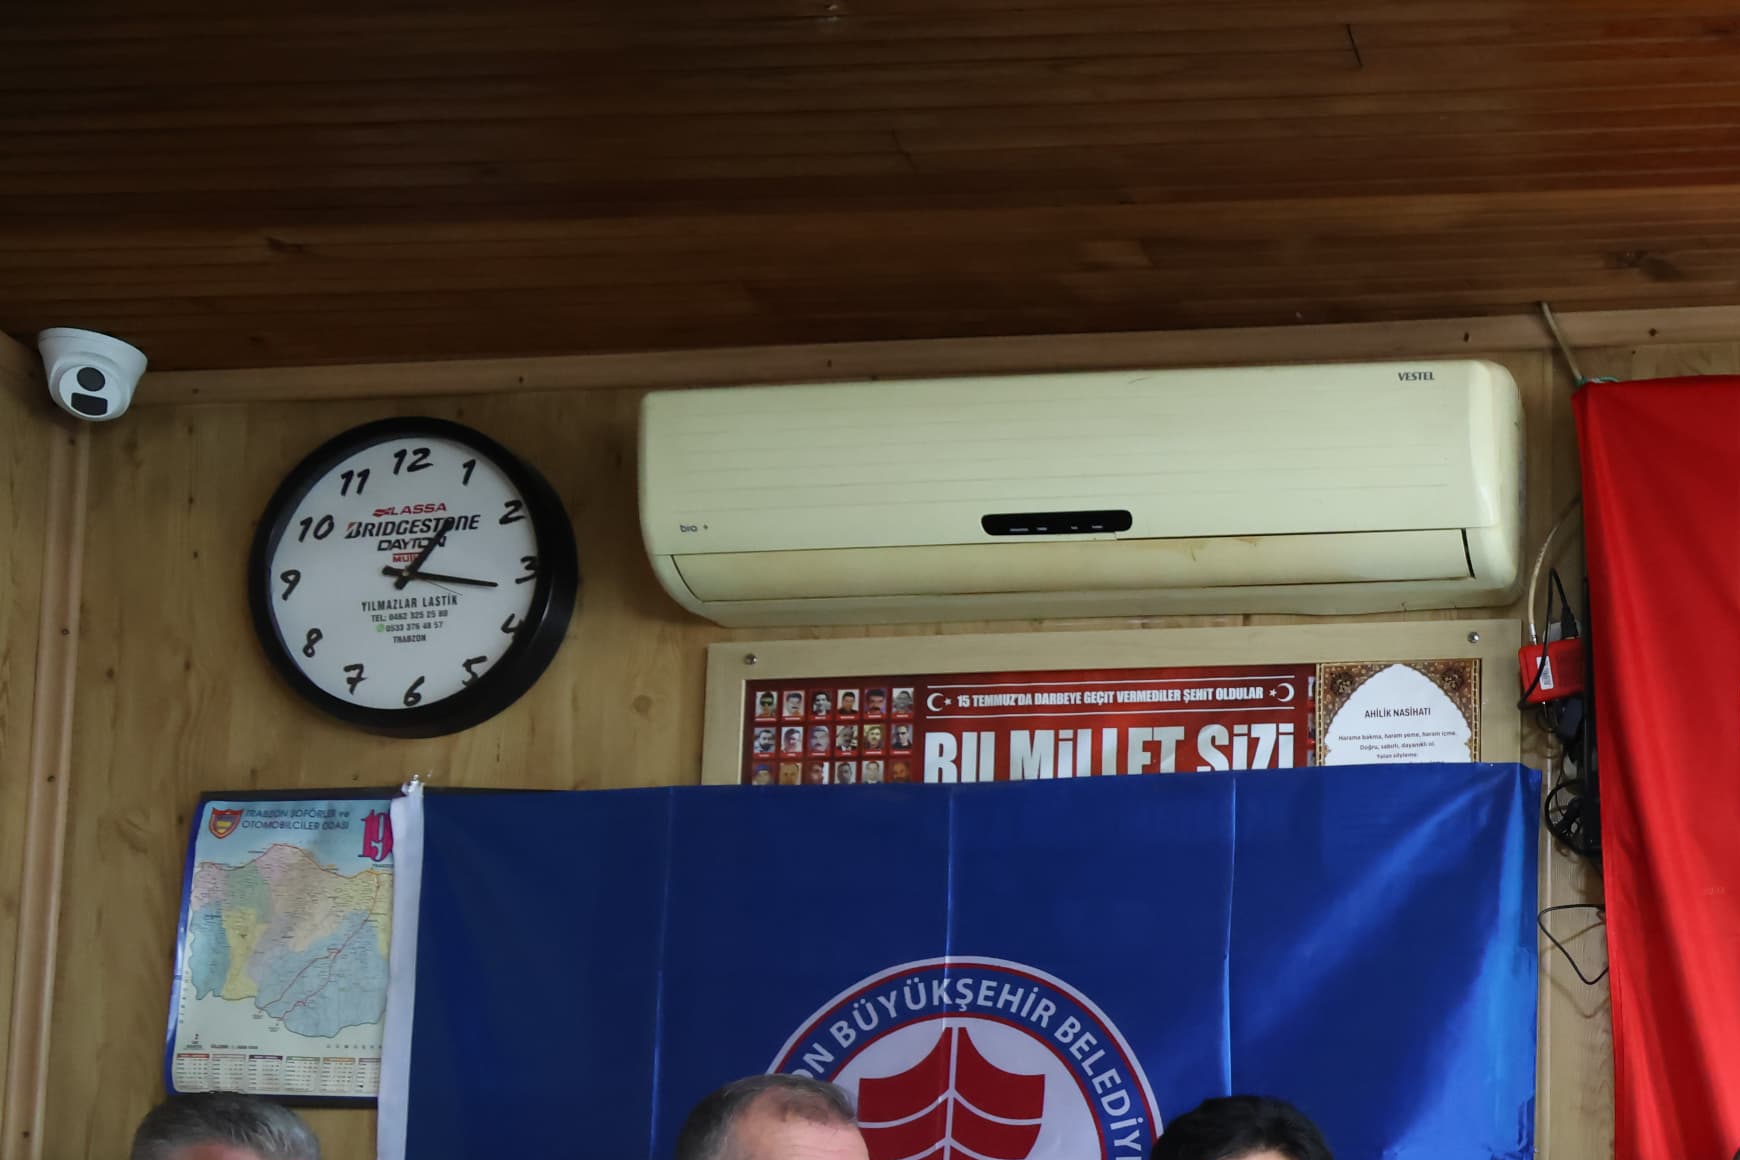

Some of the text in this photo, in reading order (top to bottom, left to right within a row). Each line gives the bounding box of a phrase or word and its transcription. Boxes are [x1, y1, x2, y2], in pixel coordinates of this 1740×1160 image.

[1398, 371, 1435, 381] VESTEL
[393, 448, 434, 475] 12
[462, 459, 476, 486] 1
[340, 468, 370, 496] 11
[390, 502, 447, 516] LASSA
[499, 500, 525, 525] 2
[298, 514, 335, 542] 10
[344, 514, 481, 539] BRIDGESTONE
[515, 556, 538, 584] 3
[280, 569, 301, 601] 9
[361, 597, 418, 612] YILMAZLAR
[501, 614, 525, 641] 4
[302, 628, 323, 658] 8
[344, 664, 368, 695] 7
[462, 656, 487, 687] 5
[403, 676, 425, 706] 6
[957, 695, 970, 708] 15
[1034, 692, 1082, 705] DARBEYE
[1215, 687, 1264, 701] OLDULAR
[830, 977, 1057, 1048] BÜYÜKŞEHİR
